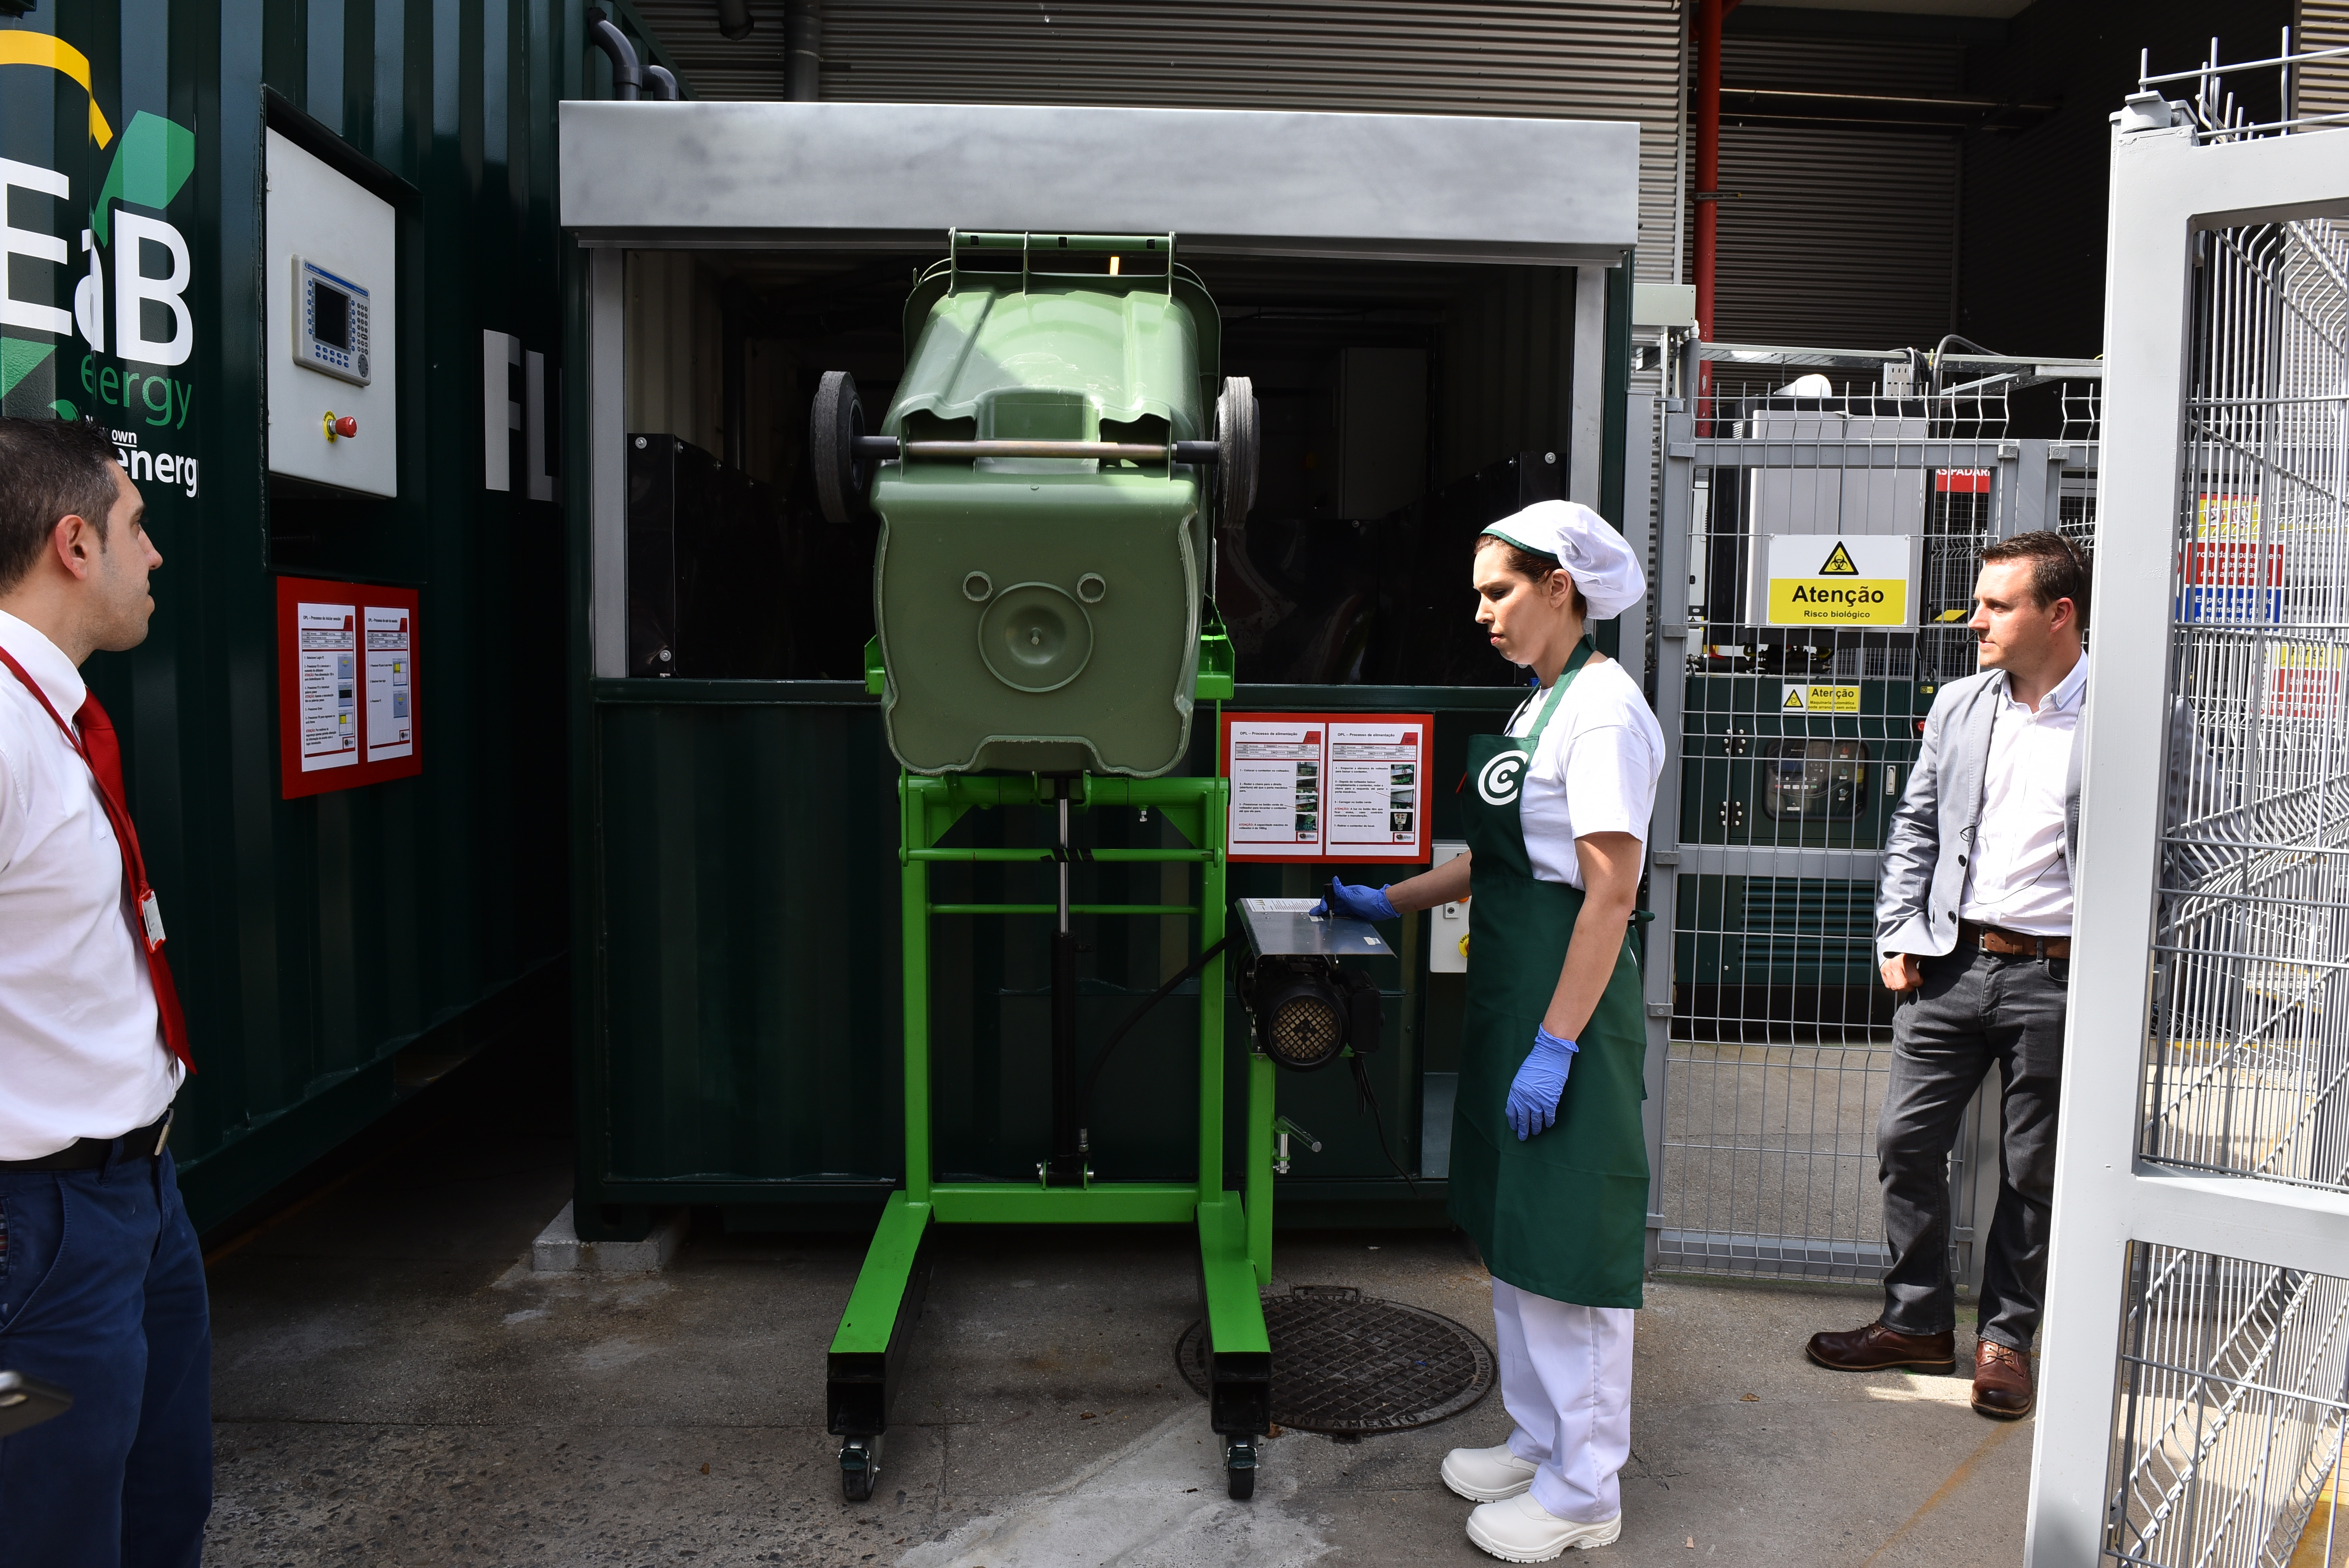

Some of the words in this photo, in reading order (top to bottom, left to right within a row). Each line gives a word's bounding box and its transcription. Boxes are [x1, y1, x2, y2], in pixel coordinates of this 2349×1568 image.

[483, 329, 562, 504] FL
[112, 429, 137, 444] own
[117, 448, 199, 498] energ
[1791, 585, 1884, 607] Atenção
[1830, 610, 1870, 620] biológico
[1271, 1413, 1418, 1428] SANEAMENTO
